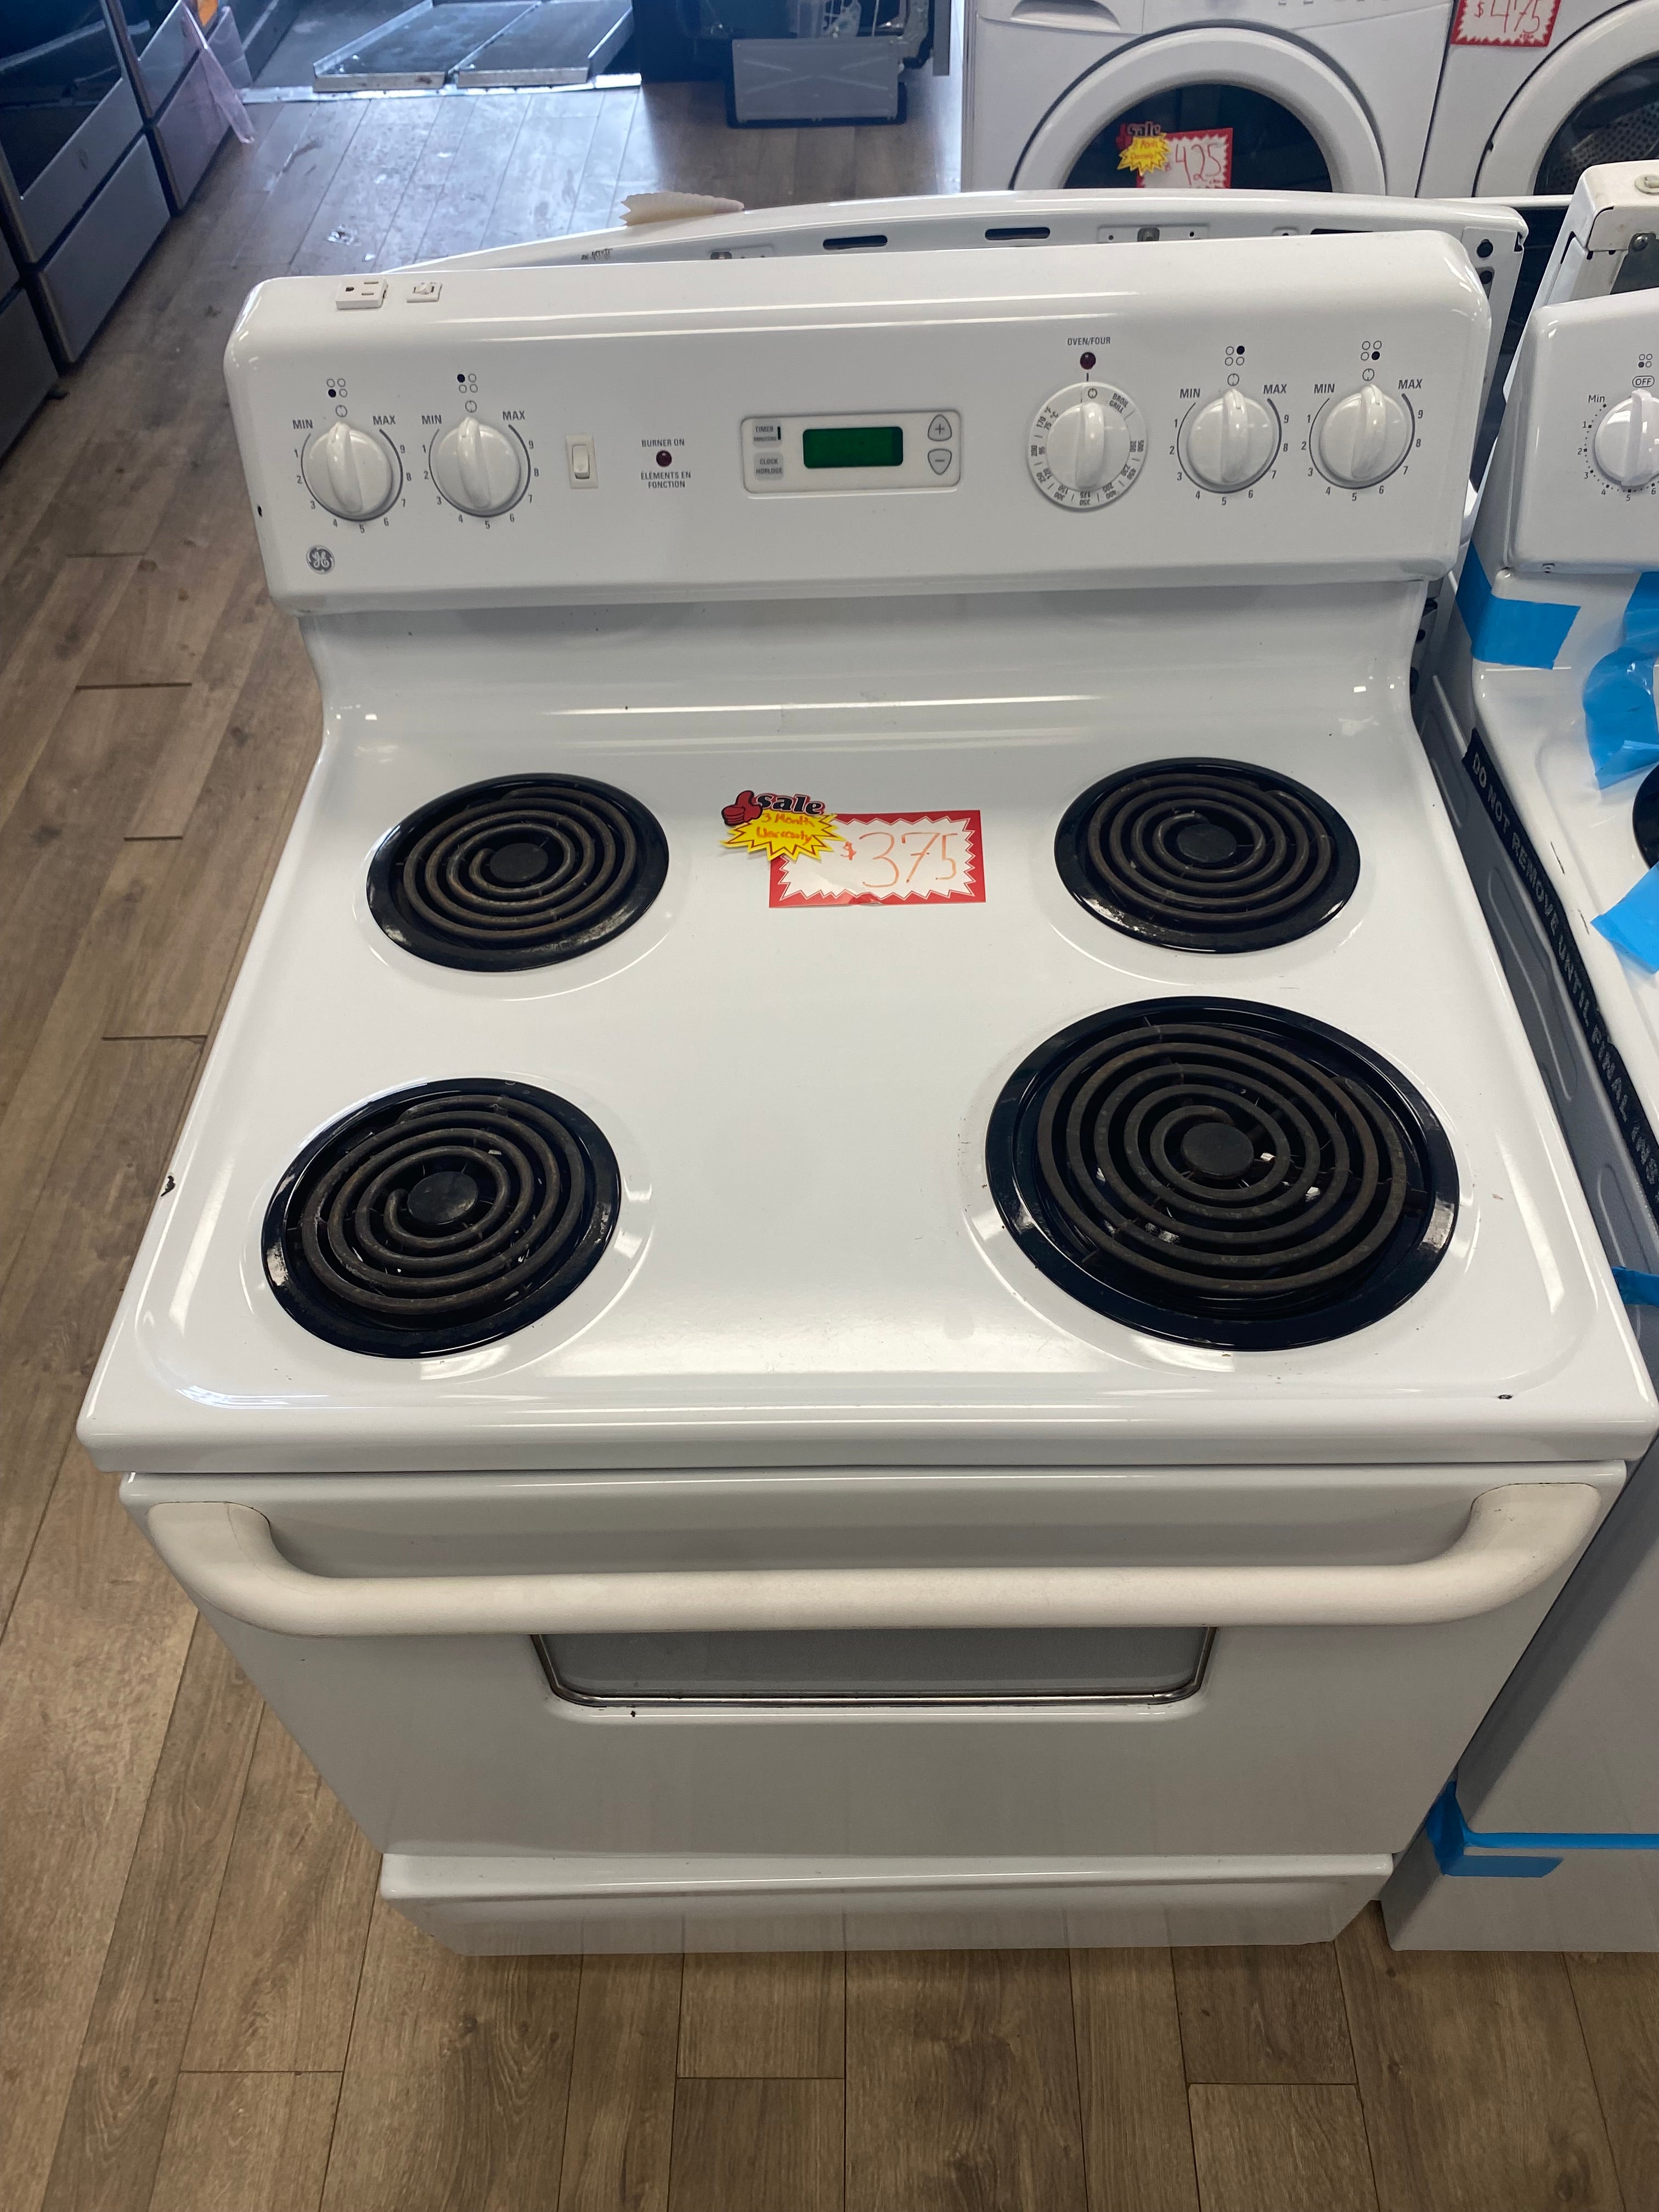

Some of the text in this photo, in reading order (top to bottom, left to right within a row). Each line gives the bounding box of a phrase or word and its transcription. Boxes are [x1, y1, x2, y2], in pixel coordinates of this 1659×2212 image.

[1067, 337, 1111, 346] OVEN/FOUR
[1263, 384, 1288, 394] MAX
[1314, 384, 1335, 394] MIN
[1398, 379, 1423, 390] MAX
[1180, 388, 1201, 399] MIN
[1113, 393, 1128, 408] BROIL
[1588, 395, 1605, 403] Min
[1109, 400, 1124, 414] GRILL
[502, 410, 526, 421] MAX
[1284, 414, 1289, 424] 9
[1306, 414, 1311, 424] 1
[1418, 410, 1423, 419] 9
[292, 419, 313, 430] MIN
[373, 415, 396, 426] MAX
[421, 415, 442, 425] MIN
[1036, 416, 1046, 427] 170
[1173, 419, 1178, 428] 1
[1043, 421, 1052, 430] 75
[528, 441, 534, 449] 9
[641, 439, 672, 447] BURNER
[1283, 443, 1288, 452] 8
[1301, 442, 1306, 450] 2
[1415, 439, 1421, 448] 8
[400, 445, 405, 454] 9
[422, 444, 426, 453] 1
[1169, 446, 1175, 455] 2
[294, 449, 298, 458] 1
[534, 469, 539, 477] 8
[1271, 470, 1277, 479] 7
[1307, 468, 1313, 477] 3
[1403, 466, 1408, 475] 7
[297, 475, 302, 484] 2
[406, 473, 411, 481] 8
[424, 471, 429, 480] 2
[1036, 472, 1046, 483] 250
[1177, 472, 1182, 481] 3
[648, 481, 685, 489] FONCTION
[1248, 490, 1254, 499] 6
[1325, 487, 1331, 495] 4
[1379, 486, 1384, 494] 6
[528, 495, 533, 503] 7
[1195, 491, 1201, 500] 4
[1352, 493, 1357, 501] 5
[401, 499, 406, 507] 7
[437, 496, 442, 505] 3
[1222, 497, 1227, 506] 5
[311, 501, 316, 510] 3
[383, 518, 389, 526] 6
[458, 515, 463, 523] 4
[509, 514, 515, 522] 6
[332, 519, 337, 528] 4
[484, 521, 490, 529] 5
[360, 524, 365, 533] 5
[757, 794, 823, 815] sale
[761, 813, 815, 827] 3 Month
[840, 832, 958, 888] $375
[1472, 752, 1487, 788] DO
[1488, 785, 1510, 833] NOT
[1512, 832, 1559, 936] REMOVE
[1558, 934, 1590, 1027] UNTIL
[1592, 1024, 1628, 1123] FINAL
